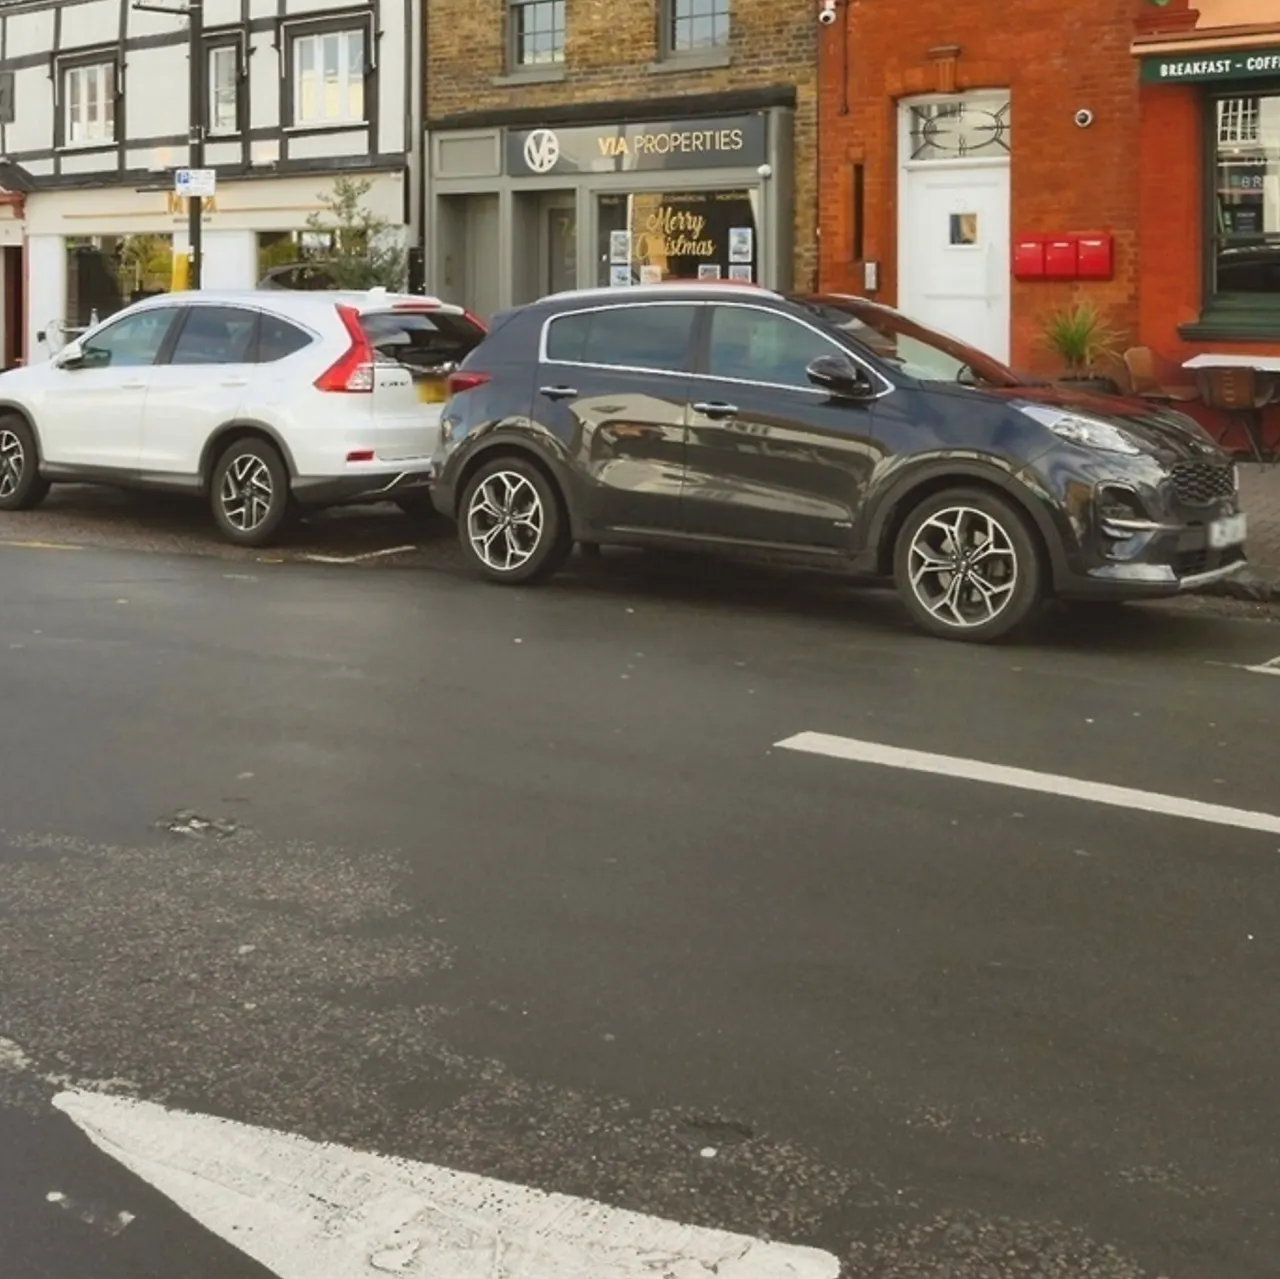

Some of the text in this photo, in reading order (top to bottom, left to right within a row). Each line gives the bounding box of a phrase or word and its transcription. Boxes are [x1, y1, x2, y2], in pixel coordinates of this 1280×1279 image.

[1160, 60, 1231, 77] BREAKFAST
[598, 129, 743, 156] VIA PROPERTIES
[646, 206, 706, 239] Merry
